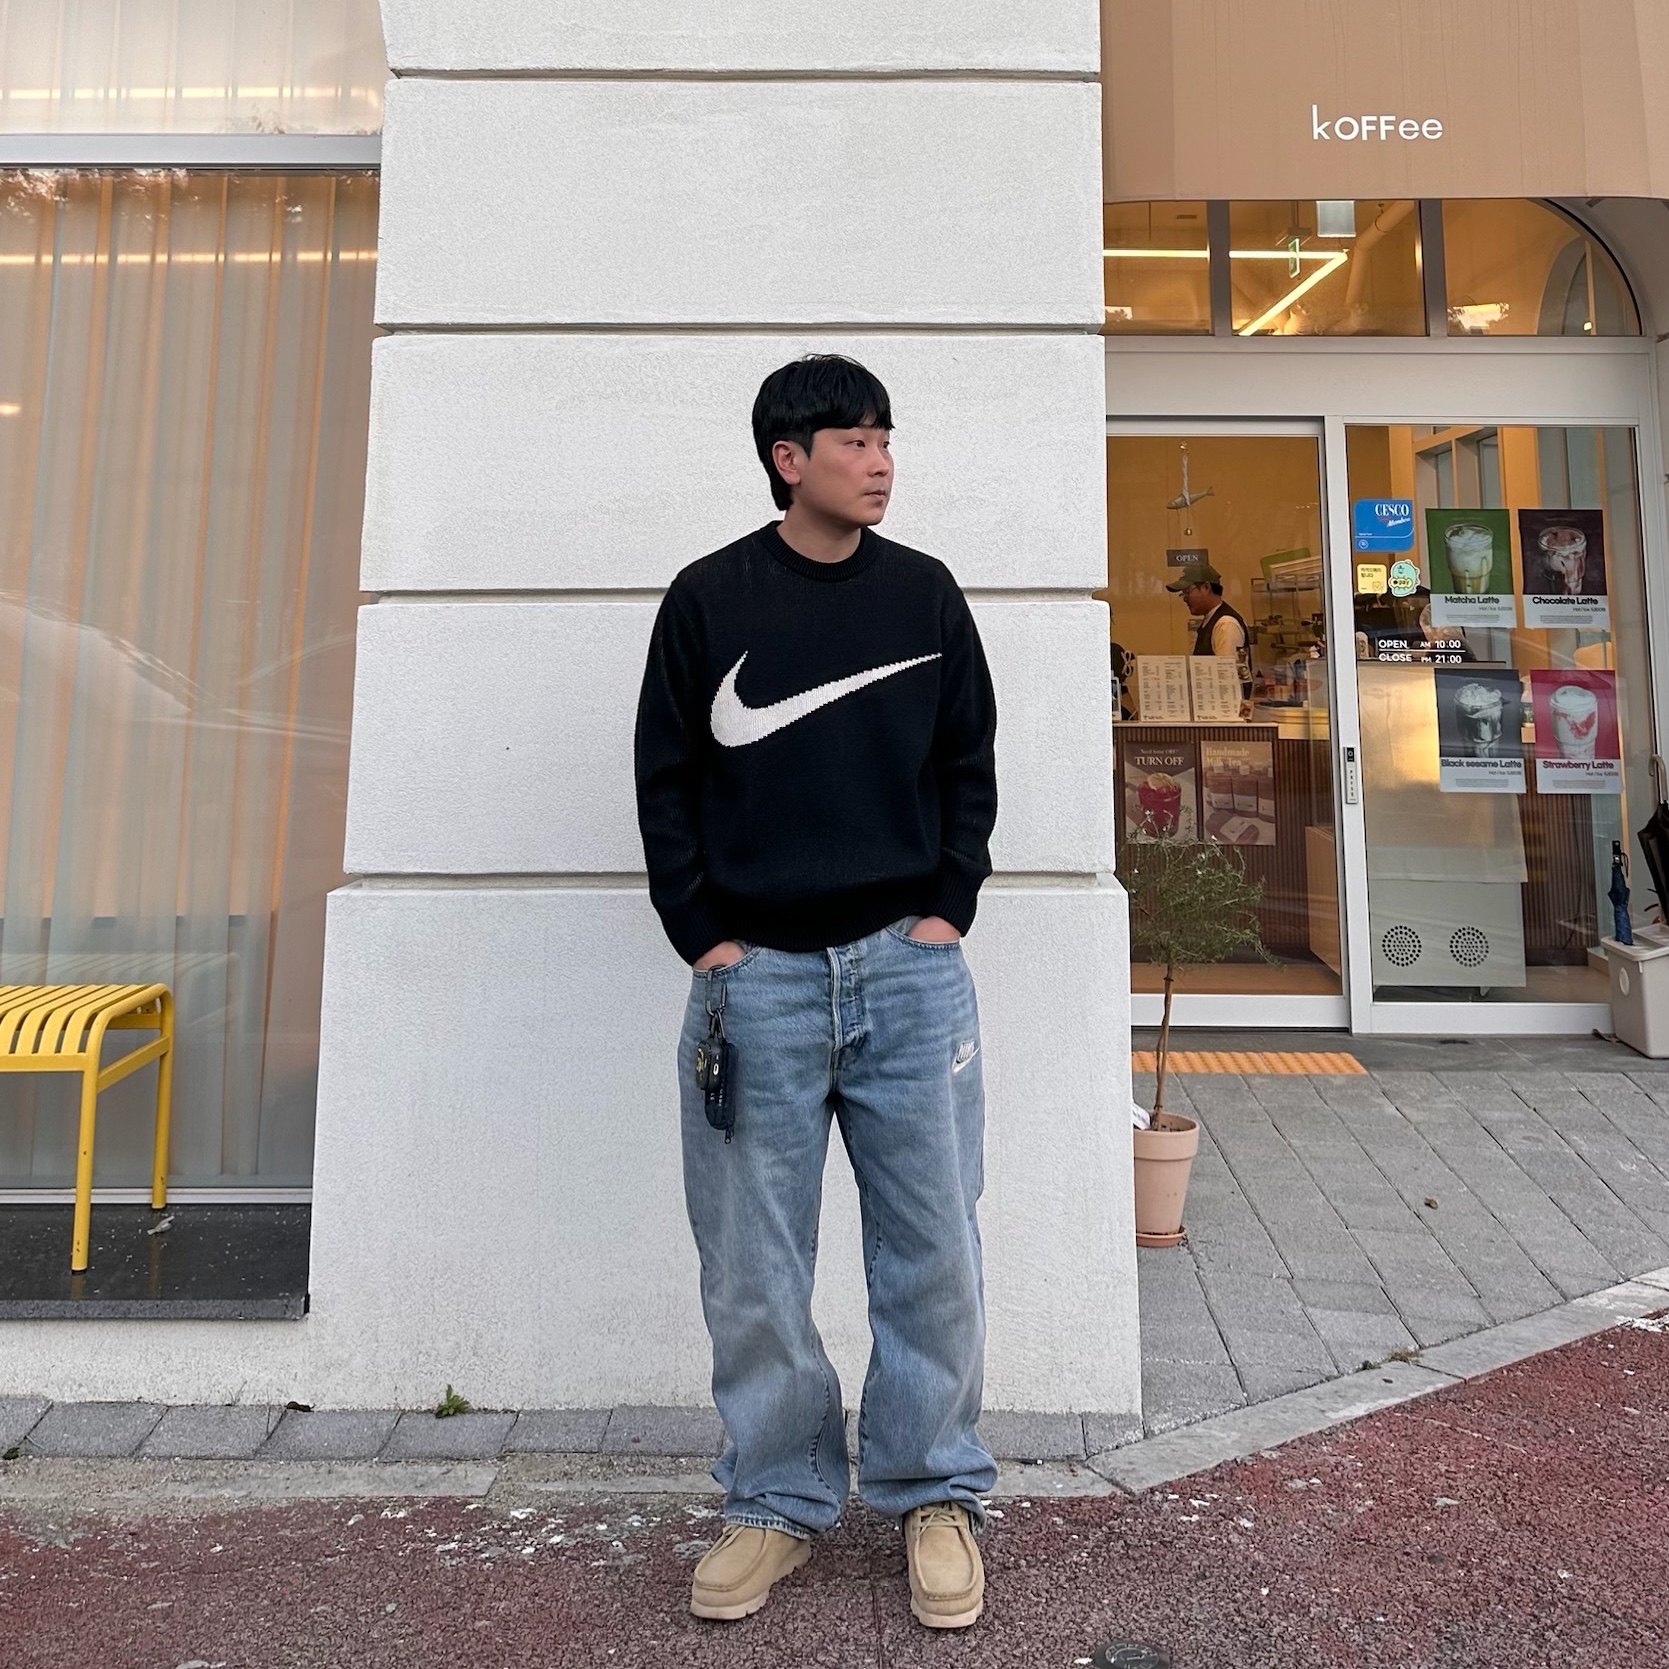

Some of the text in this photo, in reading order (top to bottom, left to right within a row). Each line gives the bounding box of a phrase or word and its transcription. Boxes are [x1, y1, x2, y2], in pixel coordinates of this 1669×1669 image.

[1311, 104, 1443, 141] kOFFee
[1375, 503, 1410, 517] CESCO
[1175, 554, 1199, 563] OPEN
[1444, 596, 1500, 604] Matcha Latte
[1532, 596, 1599, 605] Chocolate Latte
[1378, 639, 1408, 649] OPEN
[1435, 640, 1461, 649] 10:00
[1378, 653, 1412, 662] CLOSE
[1435, 655, 1462, 664] 21:00
[1135, 756, 1185, 766] TURN OFF
[1441, 759, 1522, 769] Black sesame Latte
[1542, 760, 1615, 771] Strawberry Latte
